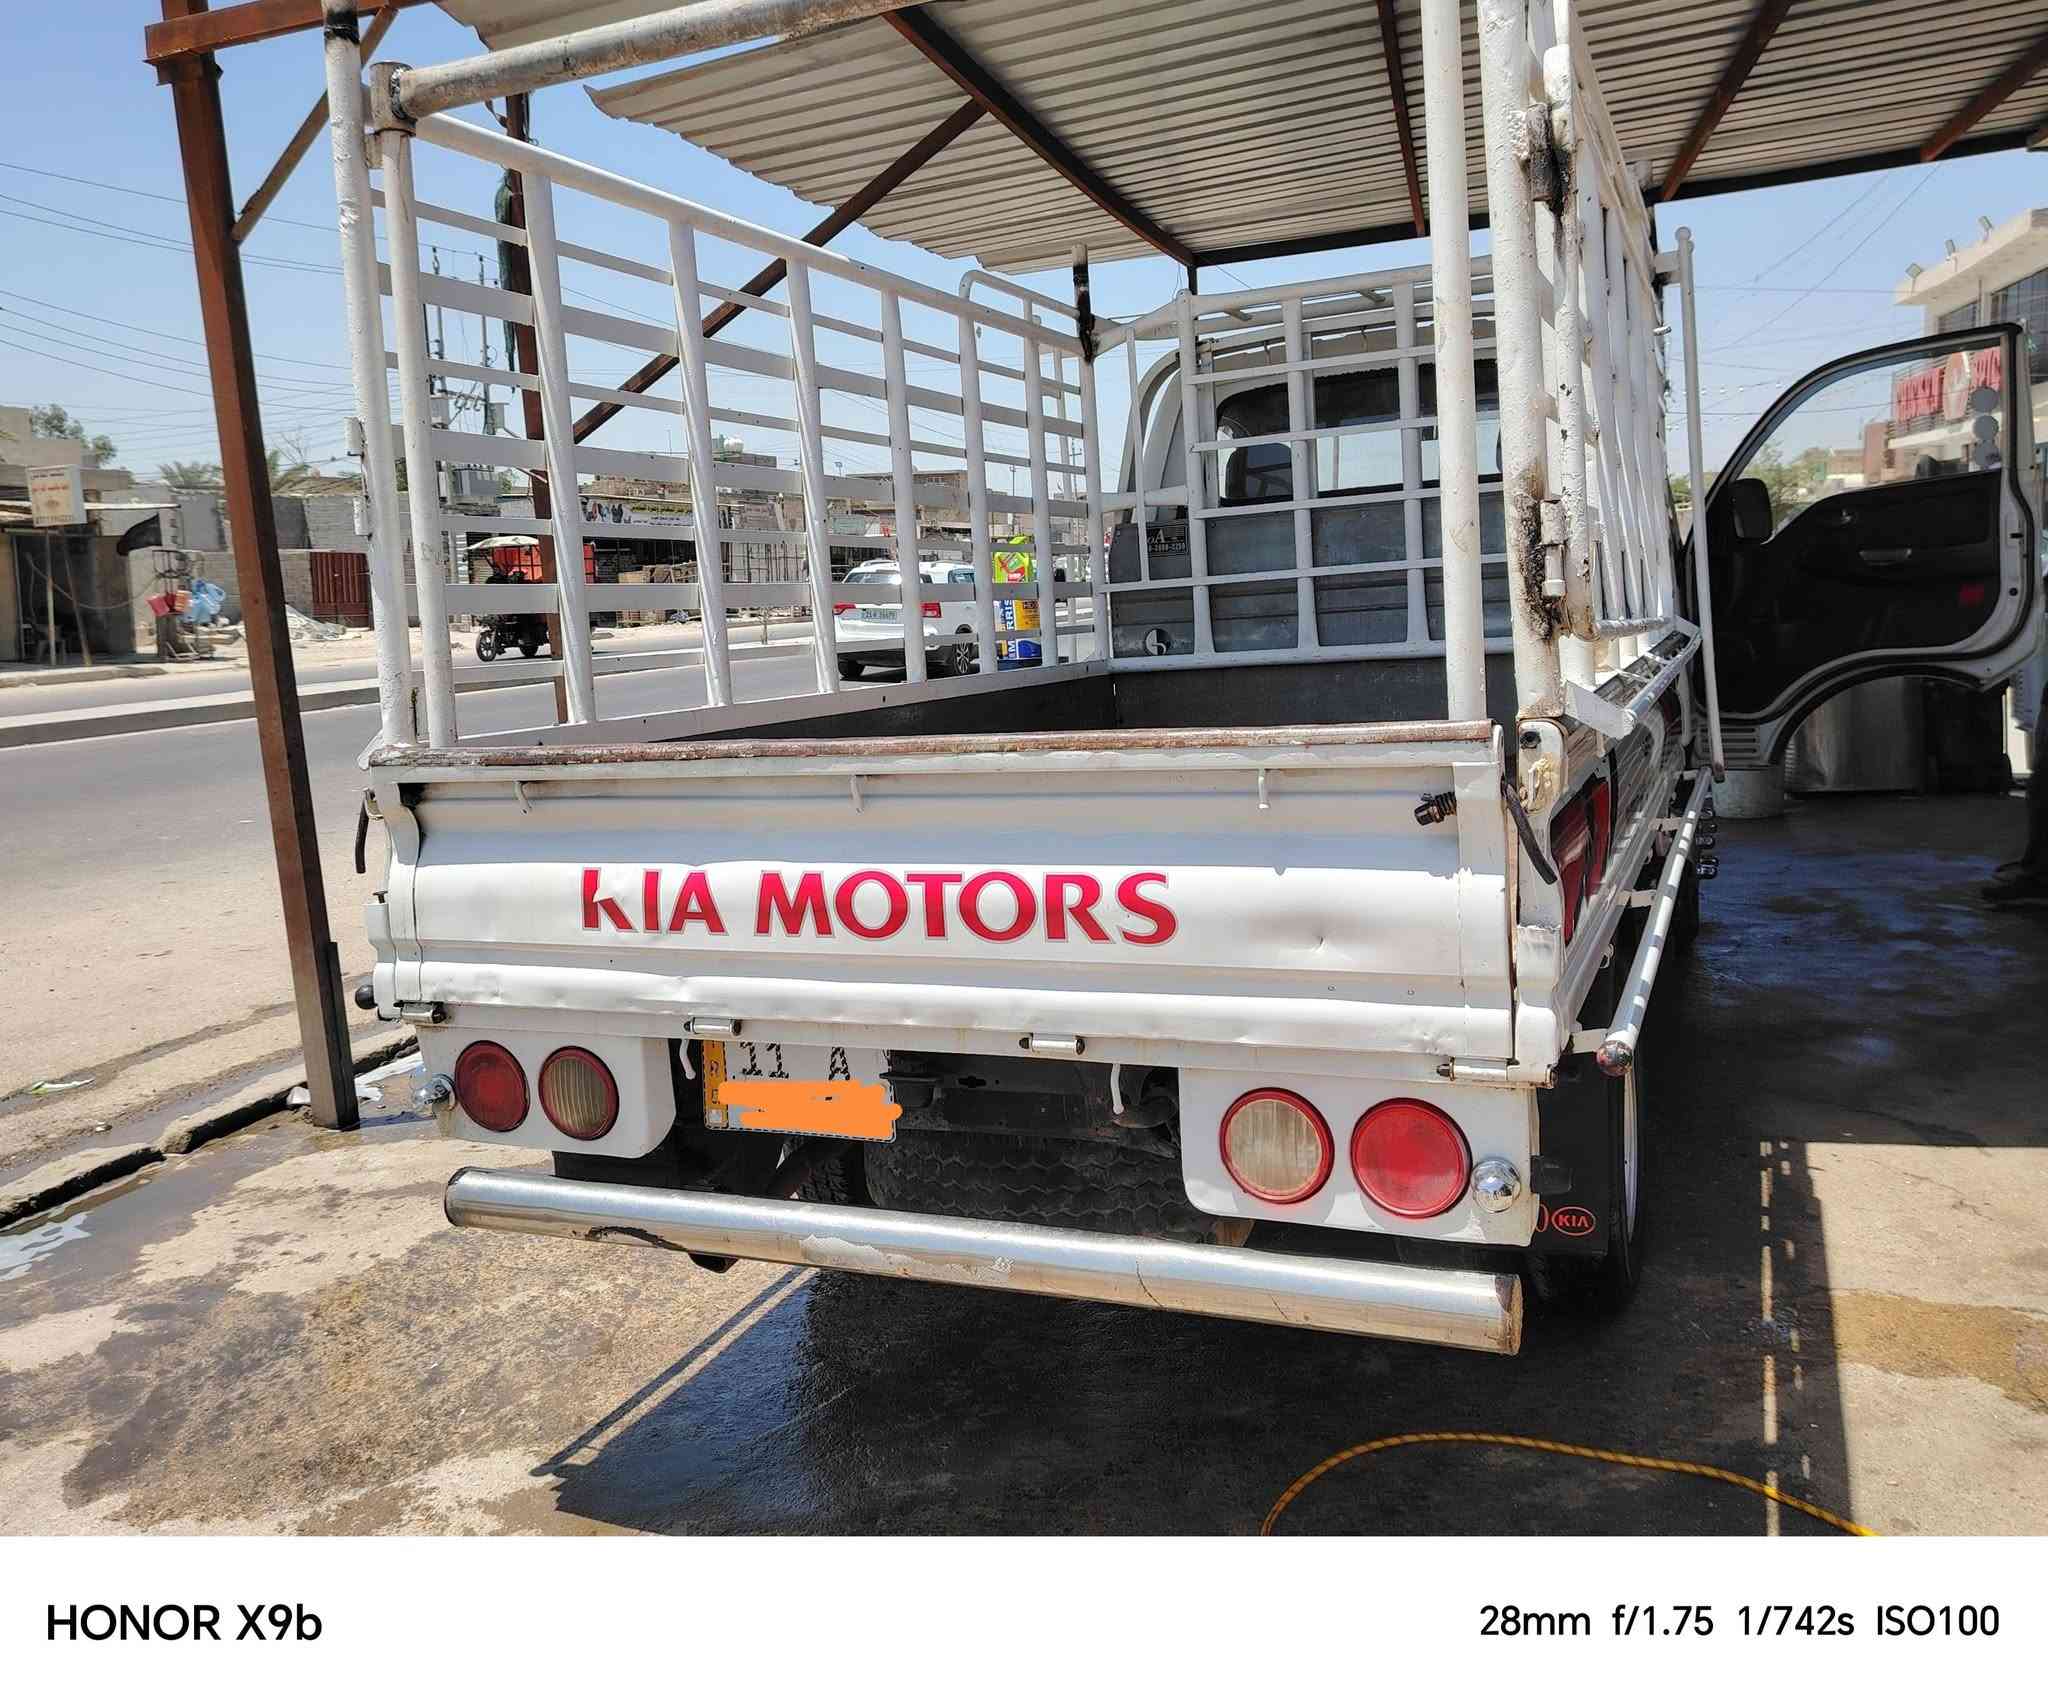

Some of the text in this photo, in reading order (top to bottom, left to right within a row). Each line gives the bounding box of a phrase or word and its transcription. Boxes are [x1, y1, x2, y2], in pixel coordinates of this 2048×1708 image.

[580, 867, 1178, 946] KIA MOTORS
[828, 1046, 851, 1081] A
[1558, 1214, 1590, 1229] KIA
